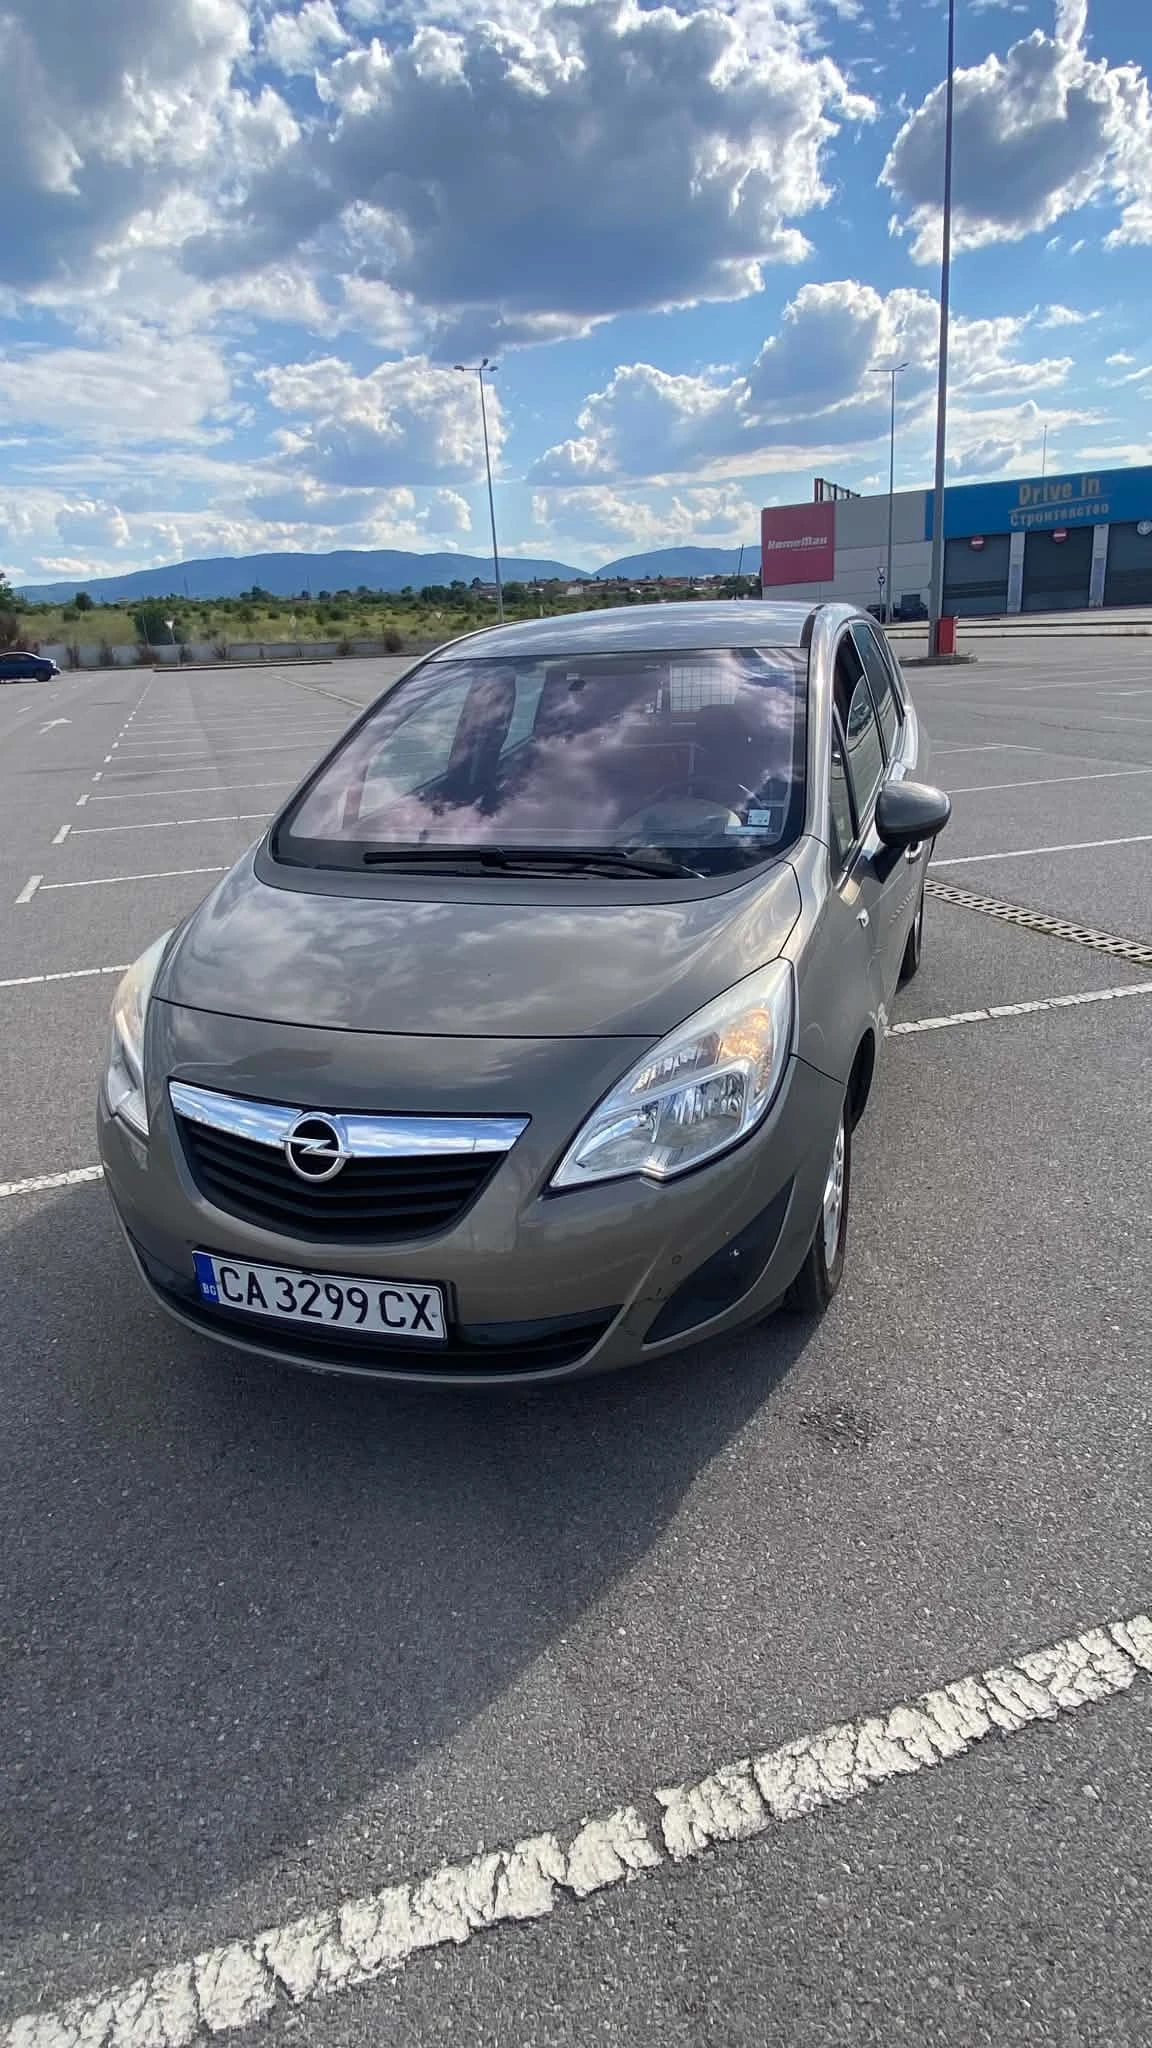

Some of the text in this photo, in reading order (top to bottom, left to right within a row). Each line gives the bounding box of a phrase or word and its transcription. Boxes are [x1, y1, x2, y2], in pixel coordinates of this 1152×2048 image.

[1019, 476, 1100, 505] Drive In
[201, 1282, 217, 1296] BG
[219, 1266, 436, 1331] CA 3299 CX
